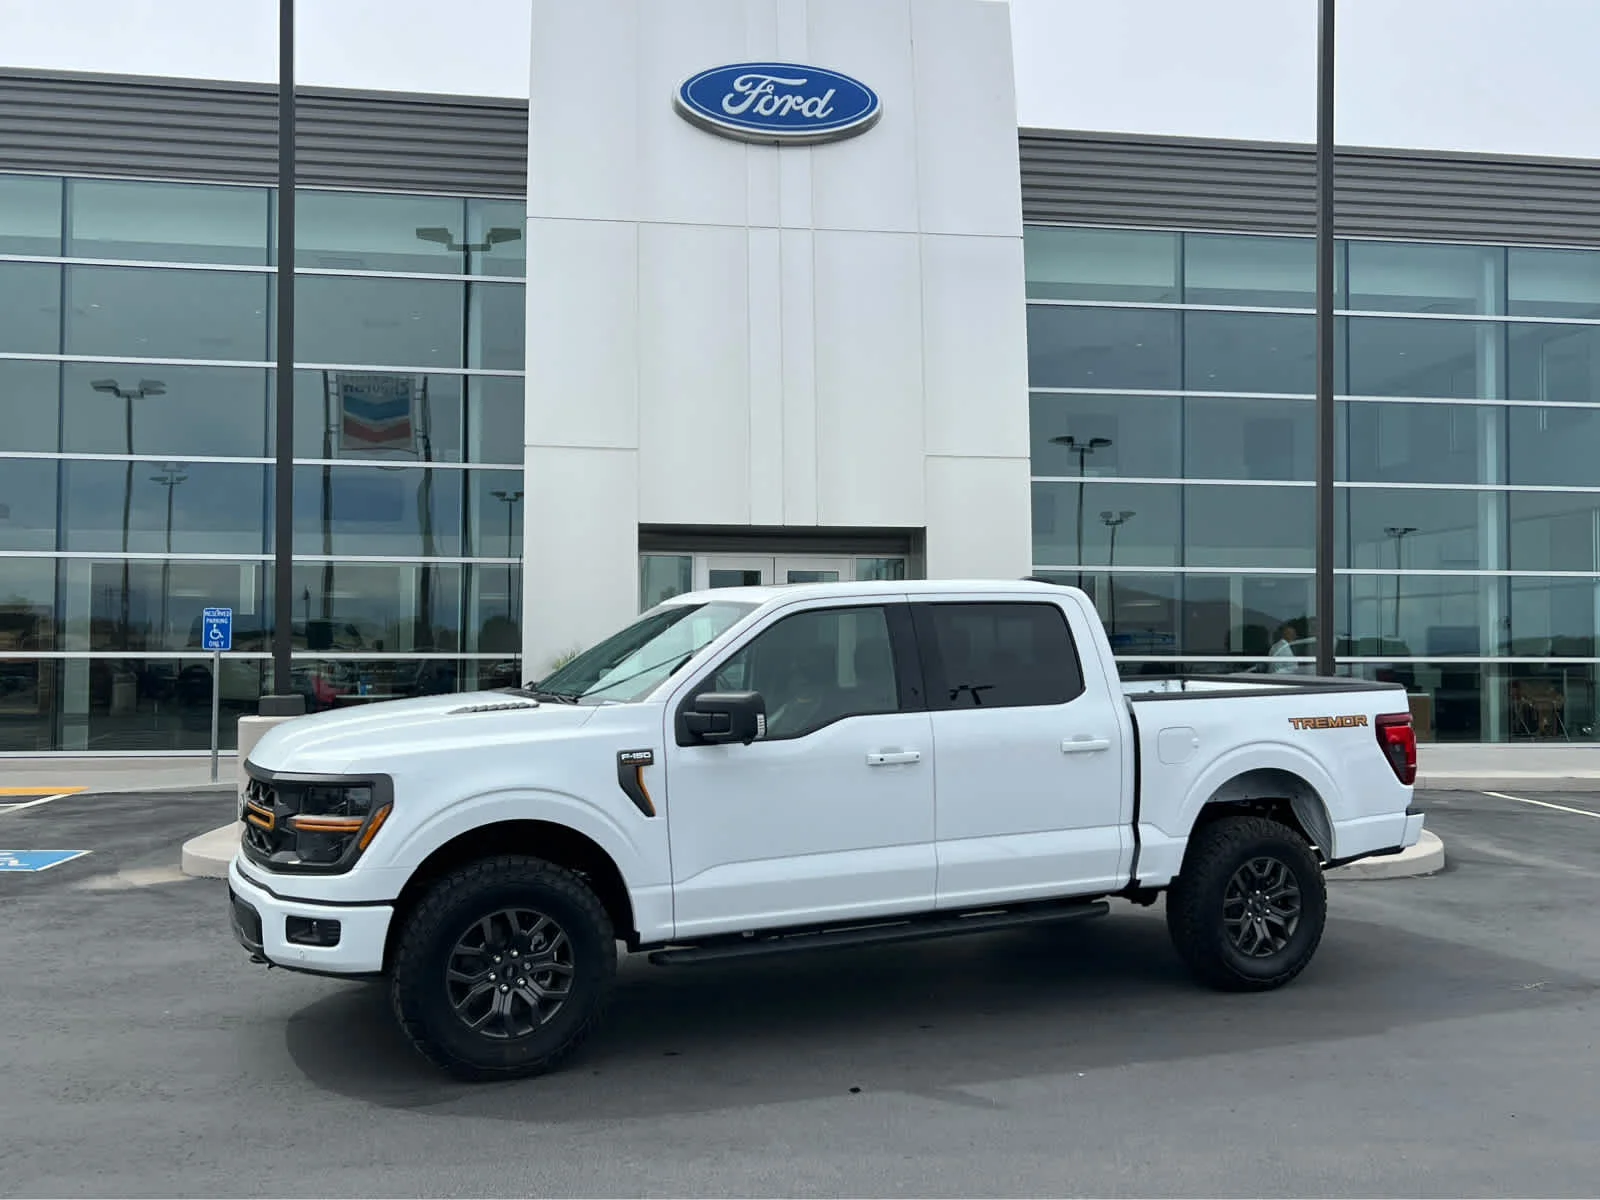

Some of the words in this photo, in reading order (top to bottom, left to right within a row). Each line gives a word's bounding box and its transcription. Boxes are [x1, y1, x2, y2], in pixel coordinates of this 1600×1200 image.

[721, 73, 836, 119] Ford
[208, 640, 224, 648] ONLY
[1288, 714, 1368, 730] TREMOR
[621, 751, 651, 760] F-150
